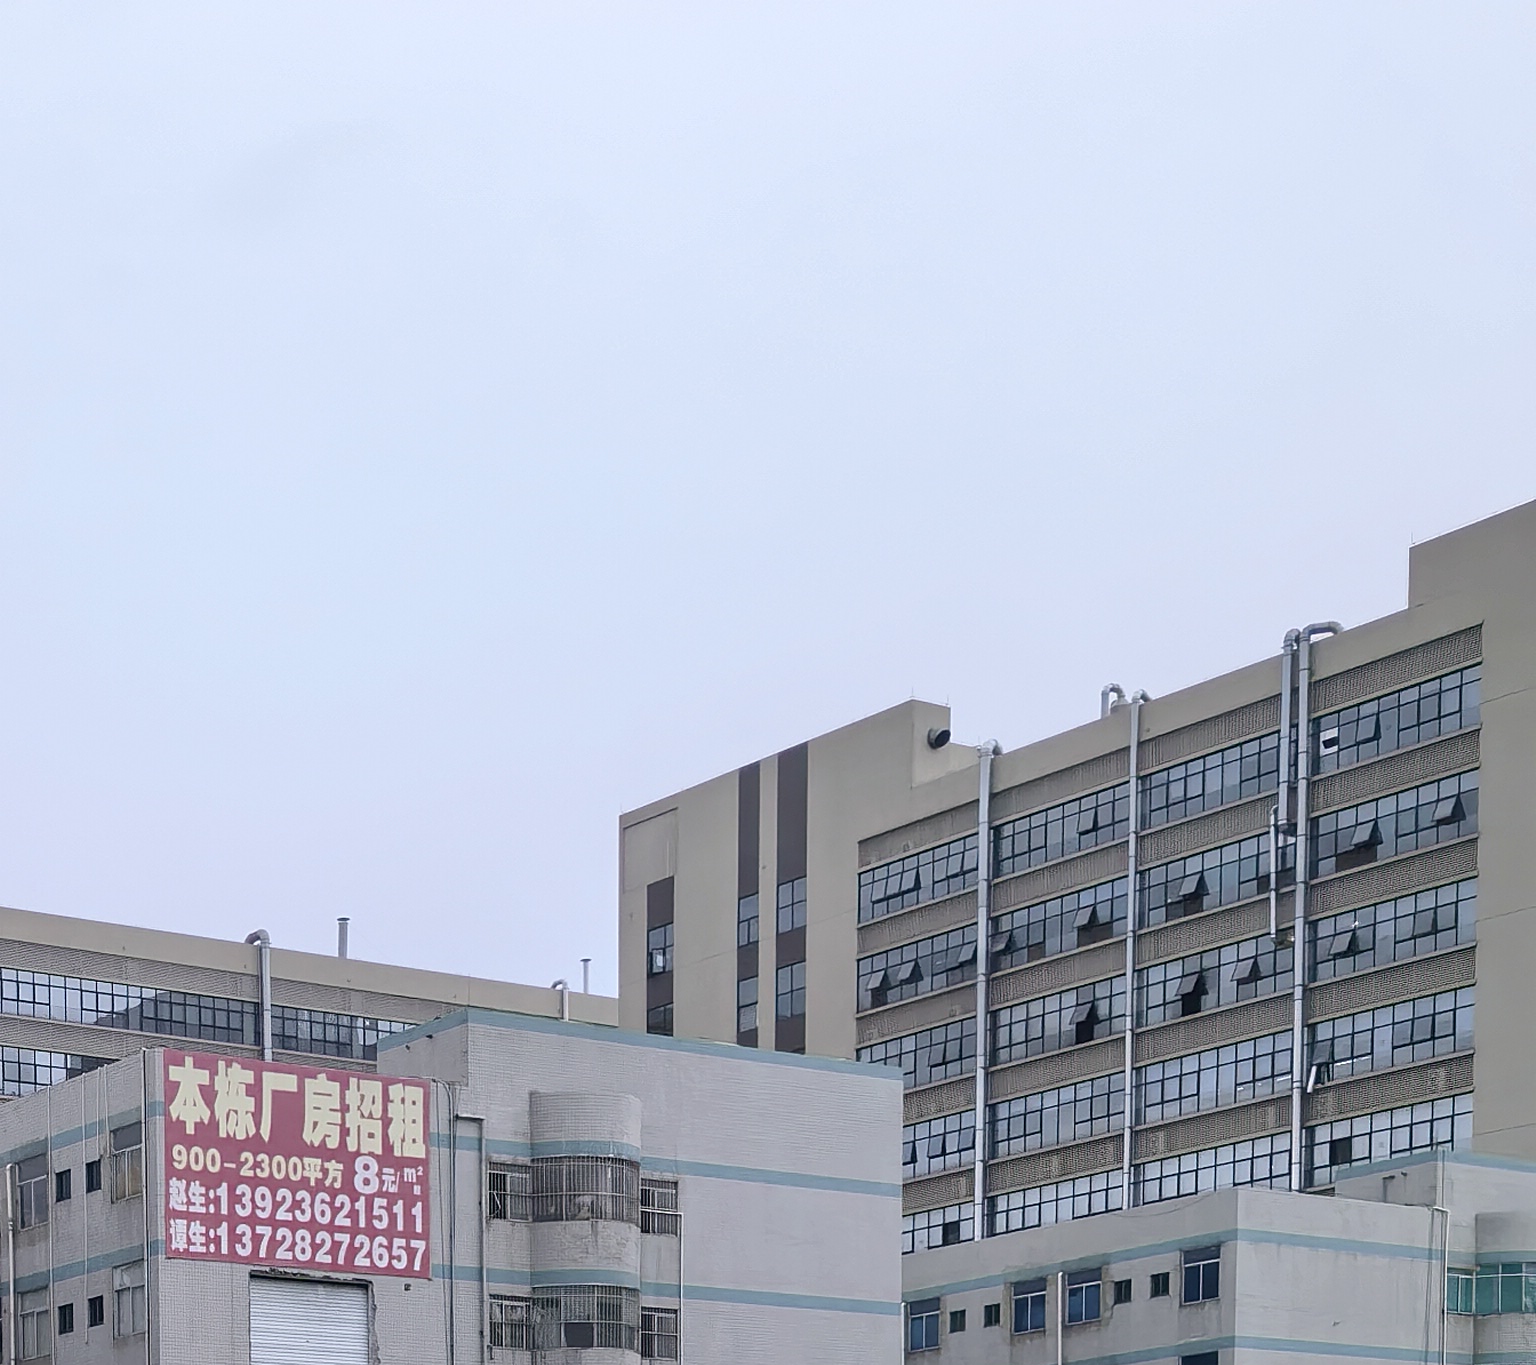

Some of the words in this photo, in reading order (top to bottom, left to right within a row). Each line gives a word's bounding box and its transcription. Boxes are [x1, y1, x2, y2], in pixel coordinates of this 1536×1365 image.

[168, 1056, 426, 1159] 本栋厂房招租
[172, 1143, 344, 1189] 900-2300平方
